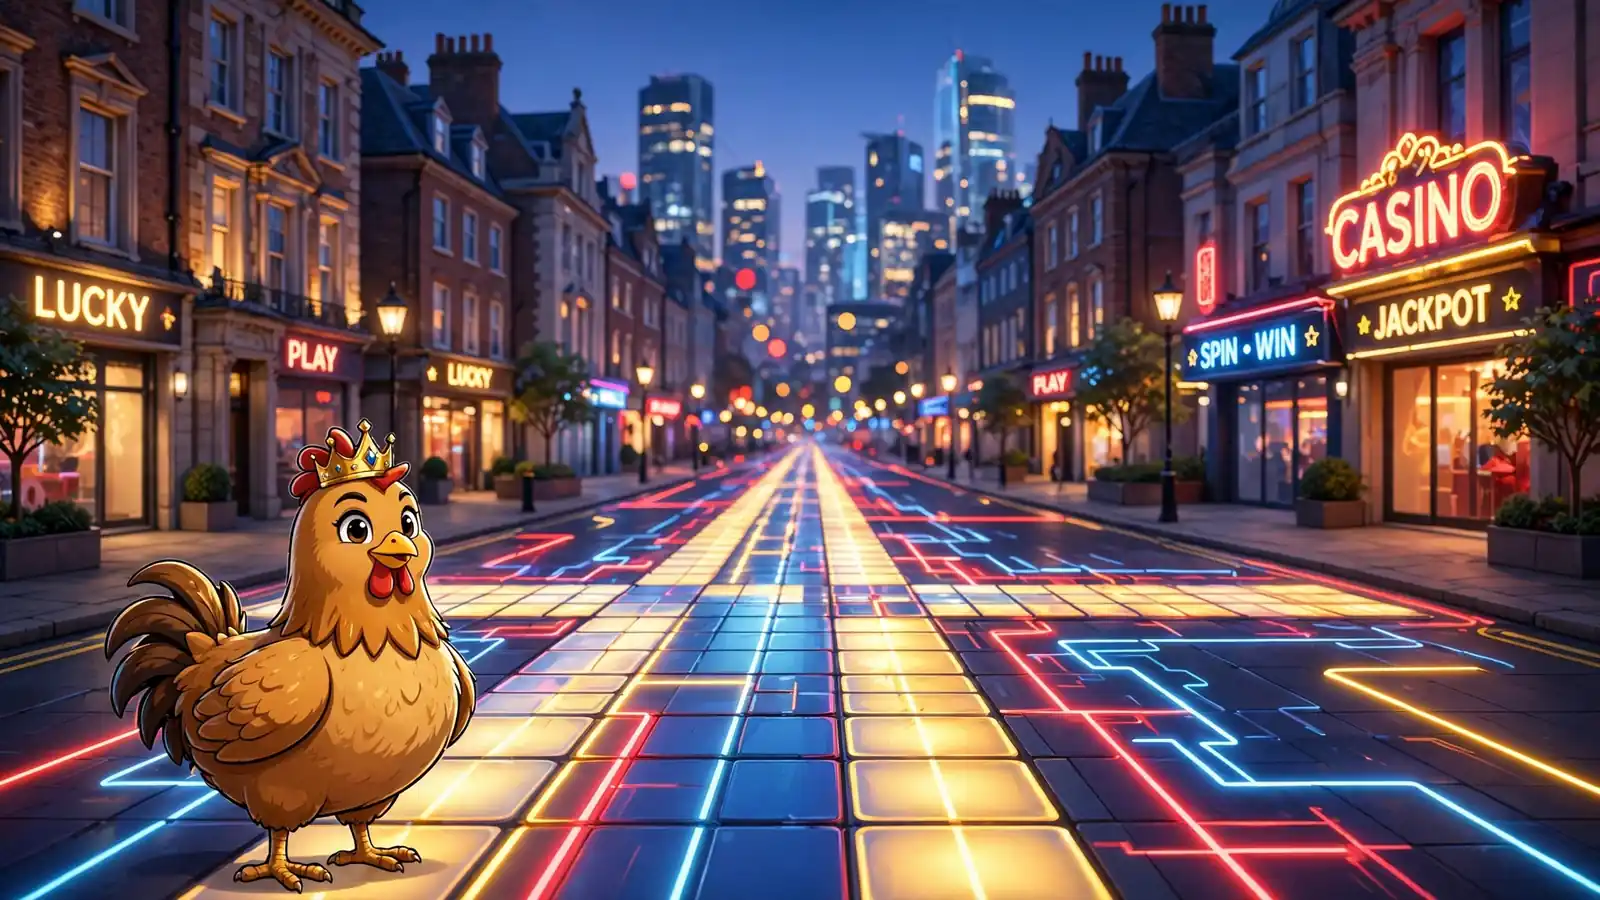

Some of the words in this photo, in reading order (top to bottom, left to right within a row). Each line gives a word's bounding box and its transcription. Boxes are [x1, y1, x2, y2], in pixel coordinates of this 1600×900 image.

[1332, 161, 1502, 269] CASINO
[34, 275, 150, 332] LUCKY
[1374, 283, 1492, 341] JACKPOT
[287, 339, 339, 373] PLAY
[1200, 336, 1238, 369] SPIN
[1256, 324, 1296, 361] WIN
[1033, 372, 1068, 395] PLAY
